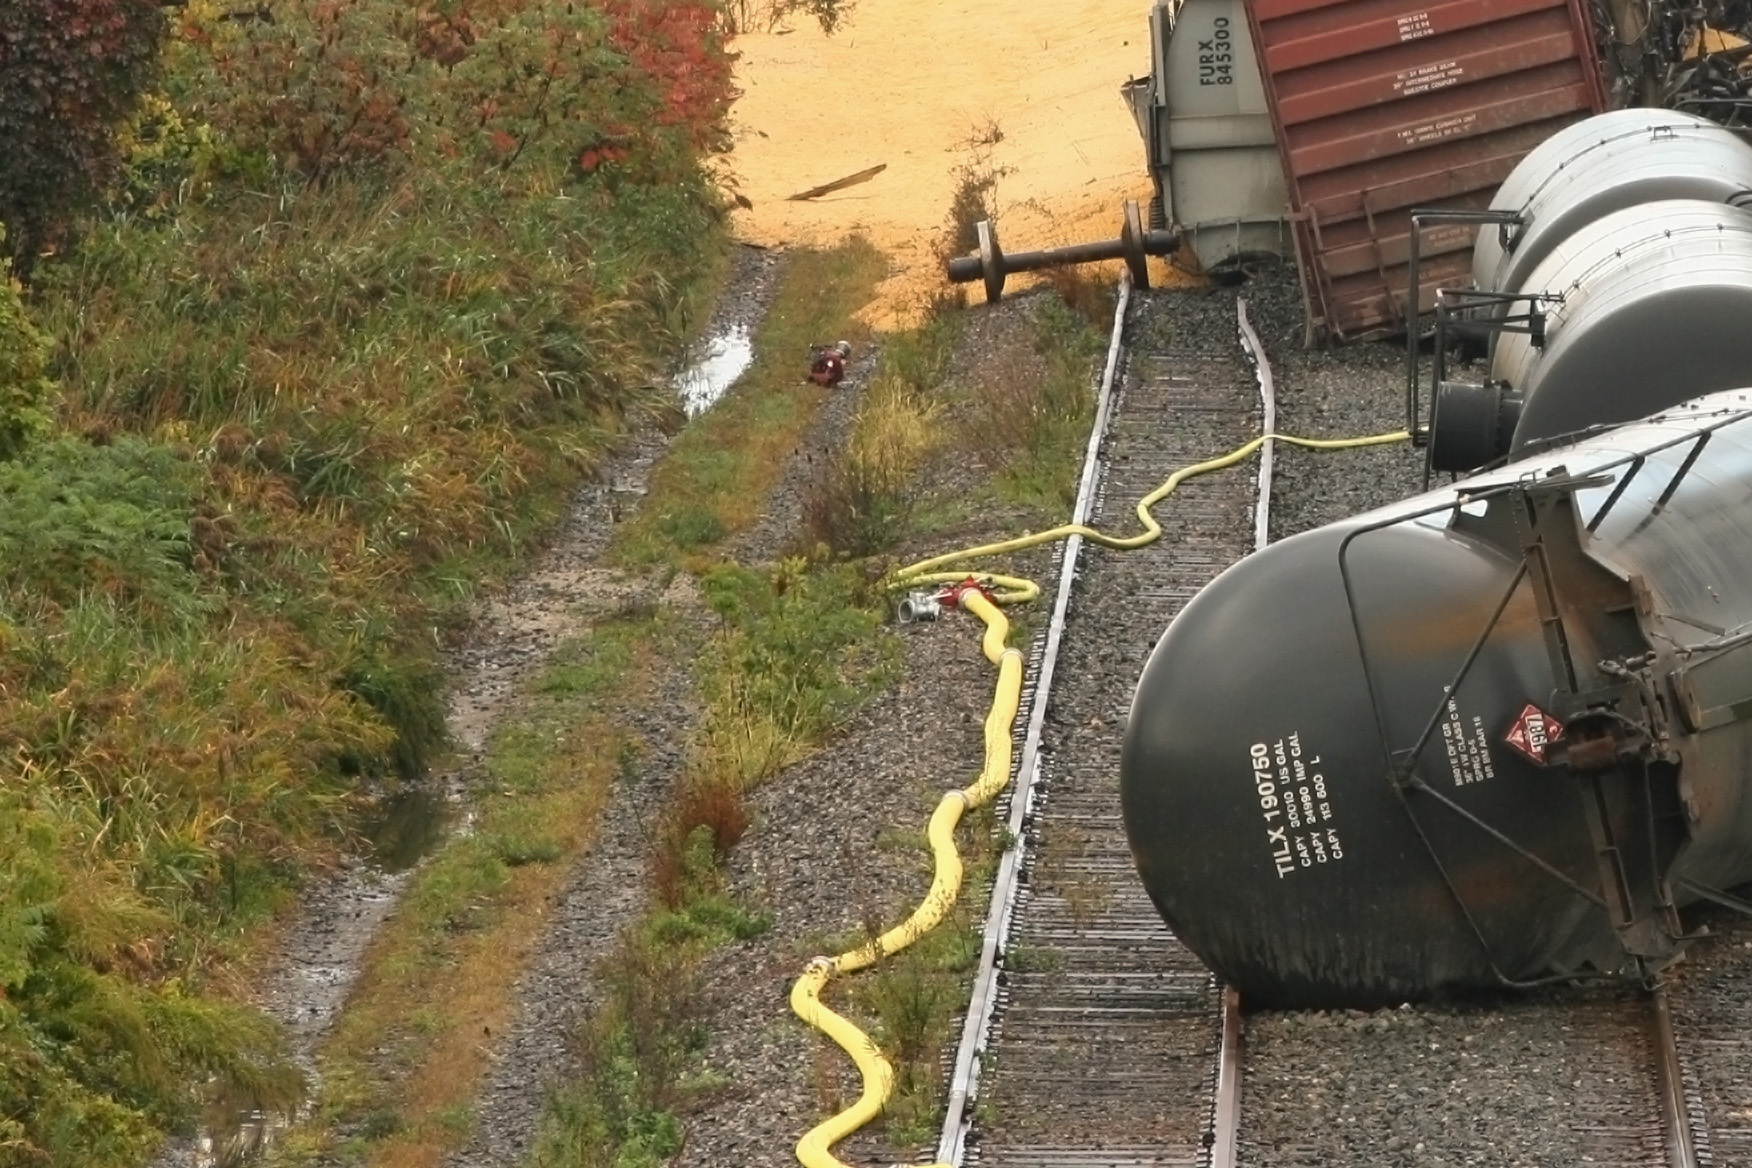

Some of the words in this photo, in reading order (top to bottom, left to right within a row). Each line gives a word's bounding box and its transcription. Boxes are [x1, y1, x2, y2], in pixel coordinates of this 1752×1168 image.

[1198, 39, 1216, 86] FURX
[1214, 17, 1232, 85] 845300
[1442, 722, 1452, 738] GR
[1450, 712, 1459, 721] C
[1274, 738, 1286, 765] GAL
[1288, 730, 1302, 757] GAL
[1452, 721, 1466, 753] CLASS
[1476, 728, 1488, 748] AAR
[1294, 760, 1306, 782] IMP
[1310, 755, 1320, 764] L
[1250, 743, 1281, 822] 190750
[1278, 766, 1290, 785] US
[1284, 791, 1300, 828] 30010
[1299, 786, 1316, 825] 24990
[1320, 802, 1332, 821] 113
[1267, 826, 1295, 879] TILX
[1294, 836, 1312, 867] CAPY
[1310, 832, 1328, 864] CAPY
[1326, 828, 1344, 860] CAPY
